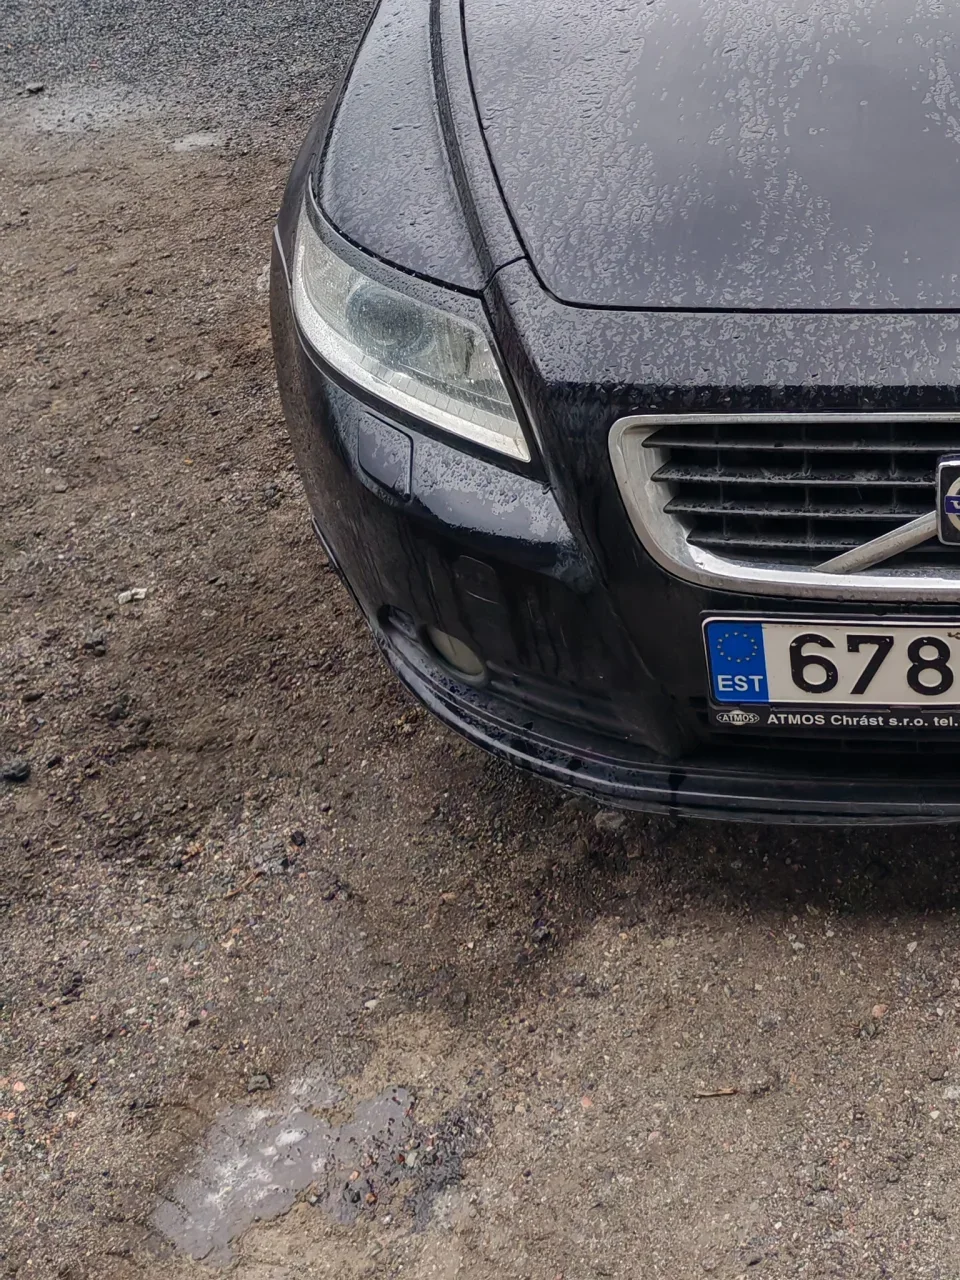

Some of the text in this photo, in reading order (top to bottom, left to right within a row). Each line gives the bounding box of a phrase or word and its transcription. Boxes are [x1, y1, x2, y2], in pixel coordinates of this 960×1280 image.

[788, 633, 954, 696] 678
[717, 674, 763, 692] EST
[721, 713, 756, 723] ATMOS
[767, 714, 825, 725] ATMOS
[830, 714, 884, 726] Chrást
[889, 716, 928, 727] s.r.o.
